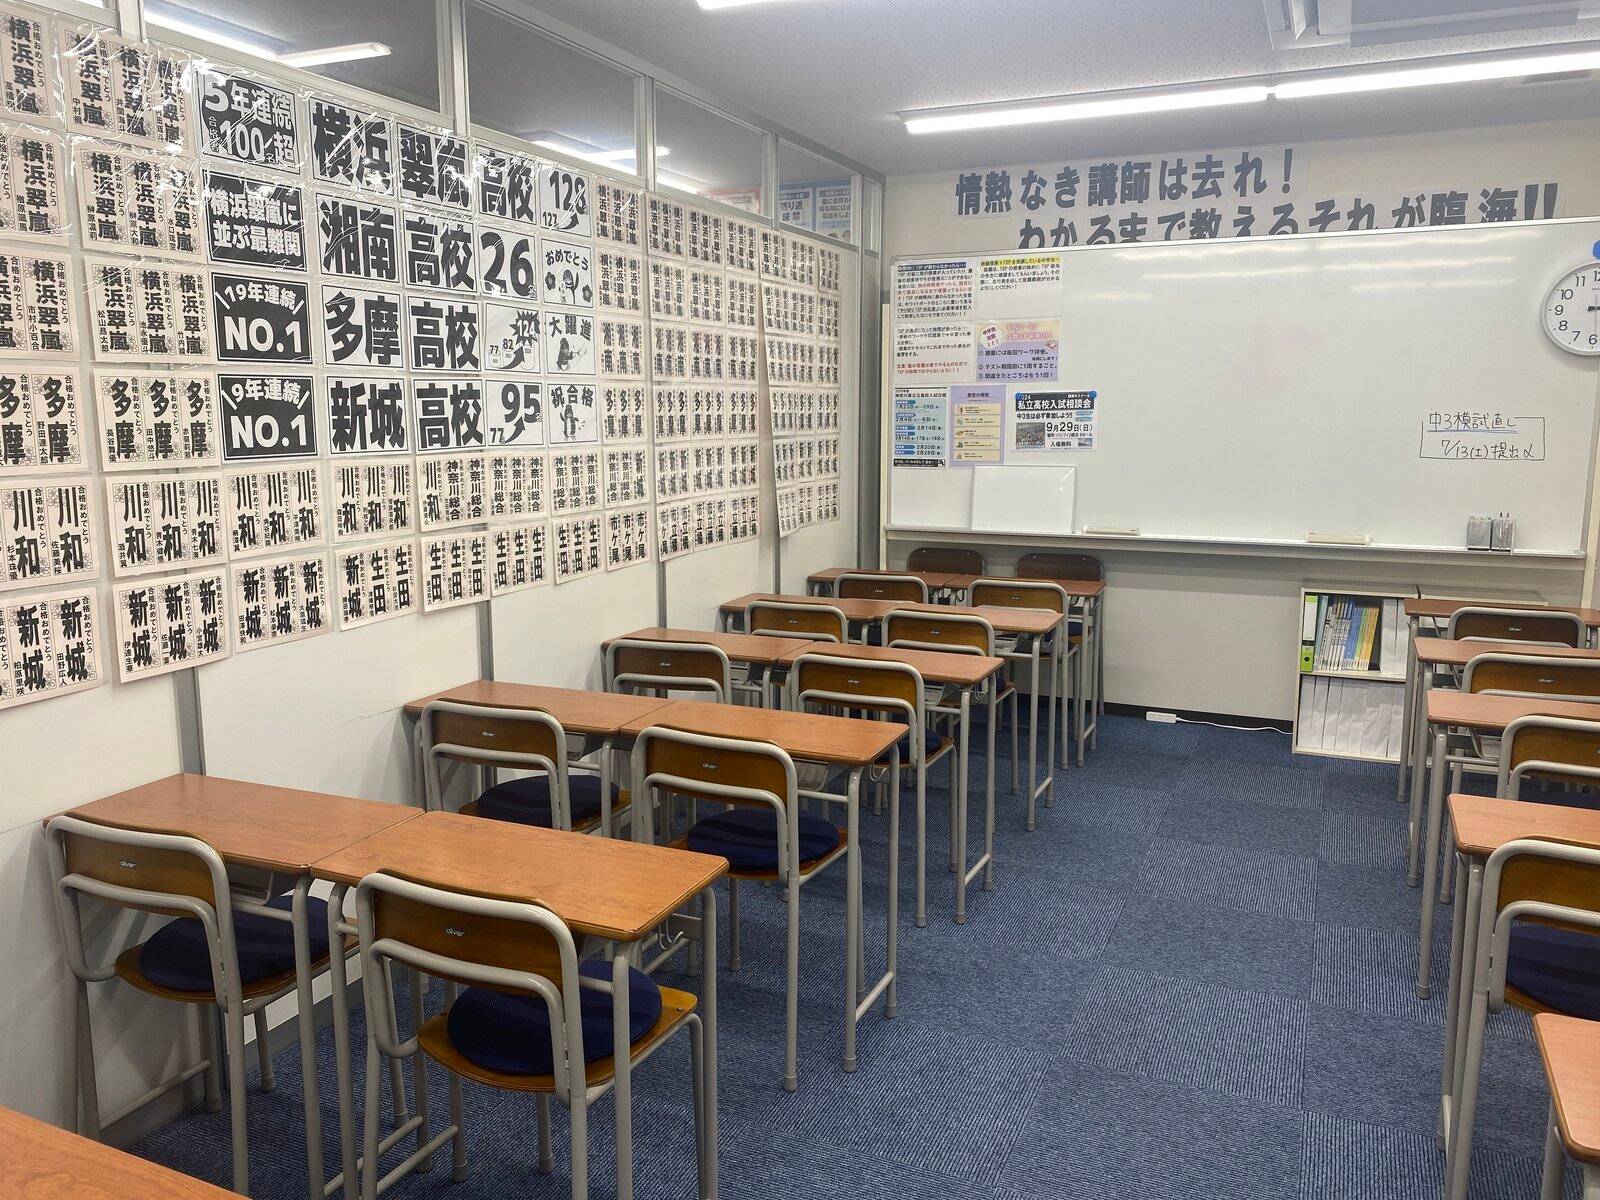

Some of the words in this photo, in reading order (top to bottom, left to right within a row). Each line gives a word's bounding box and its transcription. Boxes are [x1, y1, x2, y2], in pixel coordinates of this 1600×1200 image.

[9, 16, 39, 114] 横浜翠嵐
[21, 139, 51, 232] 横浜翠嵐
[45, 143, 57, 207] 合格おめでとう
[91, 153, 119, 240] 横浜翠嵐
[134, 161, 159, 246] 横浜翠嵐
[955, 148, 1294, 216] 情熱なき講師は去れ！
[209, 187, 299, 225] 横浜翠嵐に
[212, 219, 301, 256] 並ぶ最難関
[480, 231, 536, 297] 26
[545, 249, 589, 271] おめでとう
[10, 256, 23, 320] 合格おめでとう
[33, 259, 63, 350] 横浜翠嵐
[57, 261, 69, 324] 合格おめでとう
[102, 267, 130, 351] 横浜翠嵐
[142, 270, 168, 353] 横浜翠嵐
[163, 271, 173, 329] 合格おめでとう
[224, 282, 296, 311] 19年連続
[1555, 304, 1564, 316] 9
[1560, 288, 1574, 300] 10
[1575, 275, 1586, 288] 11
[28, 306, 39, 350] 市村小百合
[180, 274, 202, 355] 横浜翠嵐
[224, 315, 301, 353] NO.1
[502, 338, 514, 350] 82
[517, 319, 536, 338] 124
[549, 314, 592, 341] 大躍進
[1558, 320, 1568, 331] 8
[1572, 330, 1581, 342] 7
[1588, 333, 1598, 346] 6
[489, 344, 499, 354] 77
[0, 375, 26, 465] 多摩
[20, 374, 33, 436] 合格おめでとう
[43, 376, 71, 463] 多摩
[65, 375, 77, 436] 合格おめでとう
[111, 378, 136, 459] 多摩
[131, 377, 142, 435] 合格おめでとう
[150, 379, 174, 459] 多摩
[169, 378, 179, 434] 合格おめでとう
[187, 380, 208, 458] 多摩
[231, 378, 301, 405] 9年連続
[501, 383, 541, 424] 95
[551, 384, 594, 409] 祝合格
[1017, 398, 1092, 410] 私立高校入試相談会
[1429, 411, 1517, 432] 中3模試直し
[230, 414, 307, 449] NO.1
[490, 427, 504, 444] 77
[1046, 421, 1093, 433] 9月29日(日)
[78, 485, 89, 545] 合格おめでとう
[142, 482, 151, 539] 合格おめでとう
[236, 475, 257, 548] 川和
[267, 472, 286, 545] 川和
[297, 470, 316, 541] 川和
[342, 467, 357, 533] 川和
[367, 466, 382, 531] 川和
[393, 465, 407, 529] 川和
[426, 461, 440, 522] 川和
[447, 460, 460, 521] 神奈川総合
[469, 458, 482, 518] 神奈川総合
[493, 458, 505, 514] 神奈川総合
[512, 457, 522, 513] 神奈川総合
[13, 489, 40, 577] 川和
[34, 487, 47, 549] 合格おめでとう
[58, 487, 84, 572] 川和
[124, 484, 146, 564] 川和
[161, 482, 182, 561] 川和
[197, 480, 216, 556] 川和
[395, 546, 410, 609] 生田
[430, 542, 442, 602] 生田
[451, 540, 462, 600] 生田
[472, 537, 483, 596] 生田
[533, 526, 543, 580] 生田
[559, 524, 569, 576] 生田
[243, 569, 262, 640] 新城
[273, 565, 292, 635] 新城
[303, 561, 322, 629] 新城
[346, 554, 362, 619] 新城
[371, 550, 386, 615] 生田
[40, 602, 52, 662] 合格おめでとう
[60, 599, 88, 682] 新城
[82, 596, 93, 654] 合格おめでとう
[128, 589, 152, 667] 新城
[148, 587, 158, 641] 合格おめでとう
[165, 584, 187, 661] 新城
[199, 579, 219, 653] 新城
[17, 605, 46, 691] 新城
